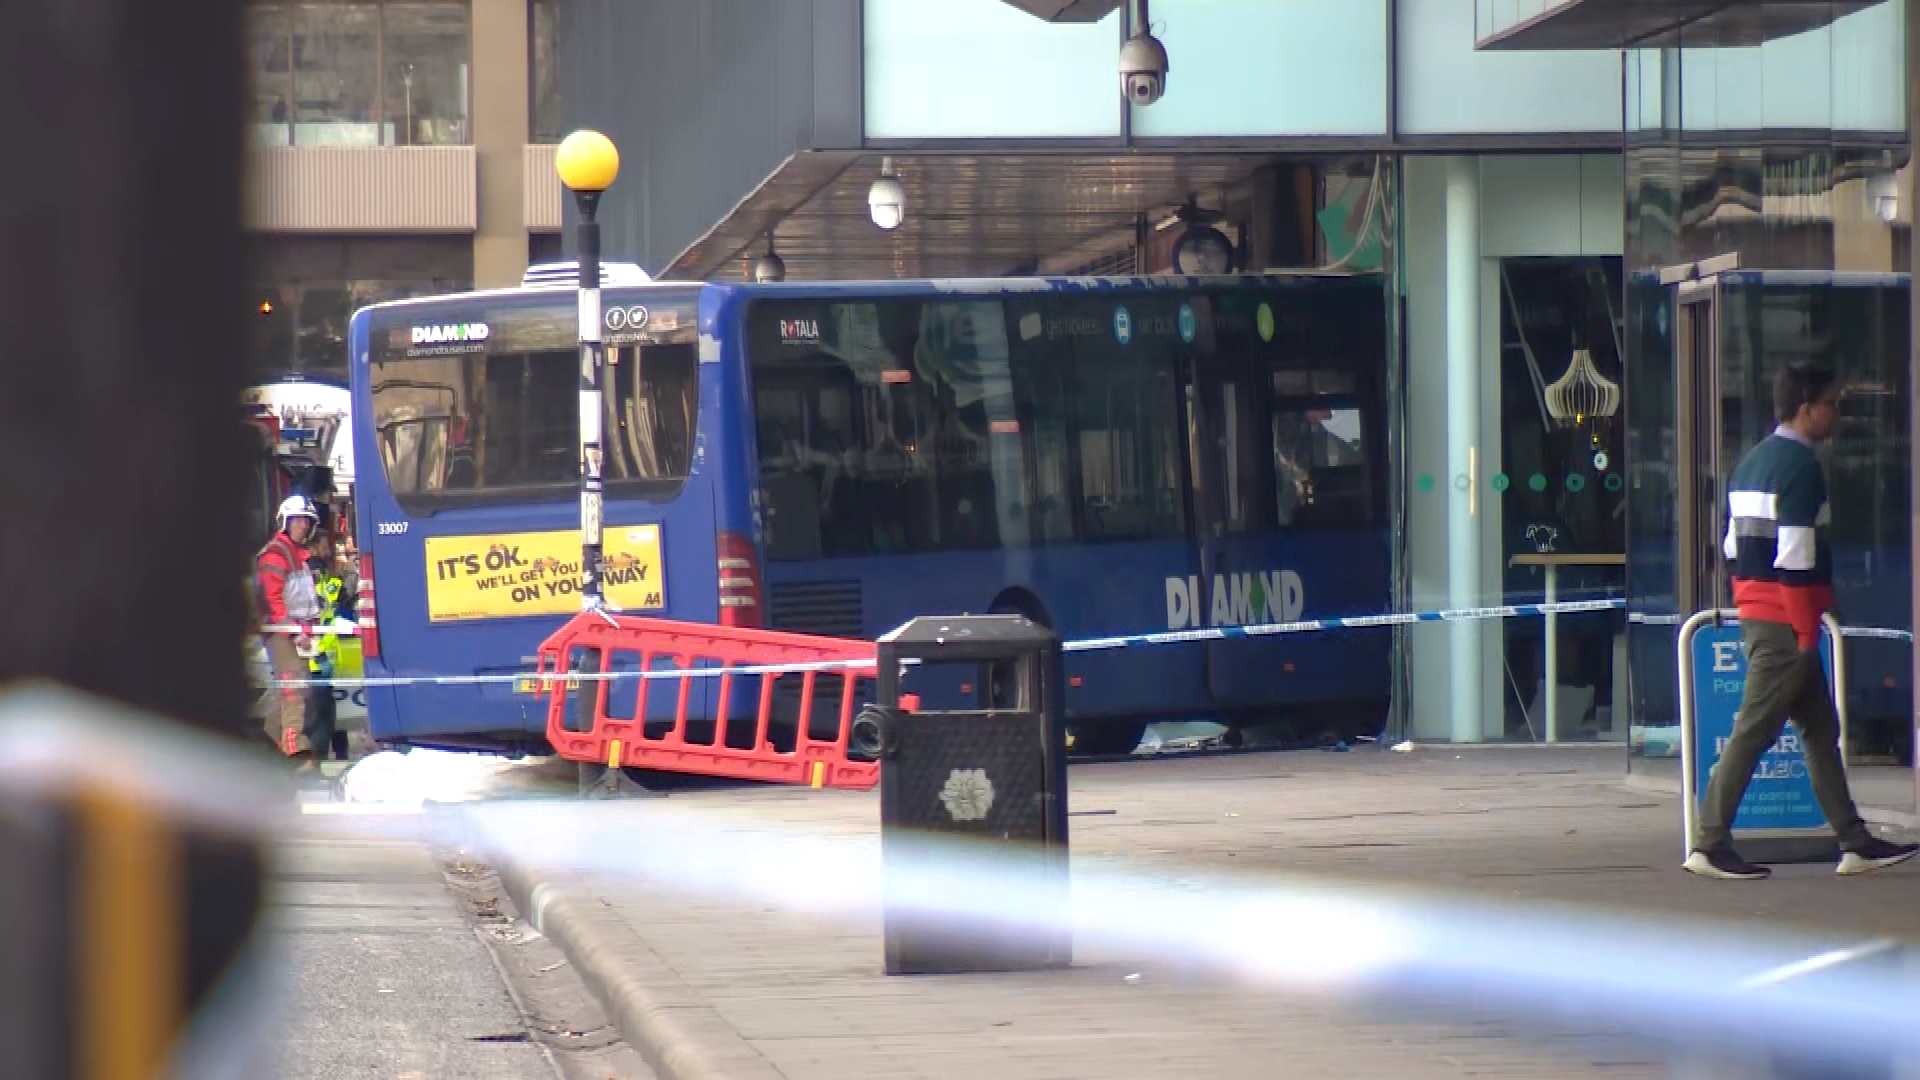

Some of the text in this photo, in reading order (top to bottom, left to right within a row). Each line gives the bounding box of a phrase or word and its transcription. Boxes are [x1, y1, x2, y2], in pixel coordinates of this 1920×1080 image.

[378, 522, 408, 535] 33007
[437, 553, 481, 581] IT'S
[476, 562, 579, 591] WE'LL GET YOU
[511, 564, 648, 603] ON YOU WAY
[644, 591, 661, 607] AA
